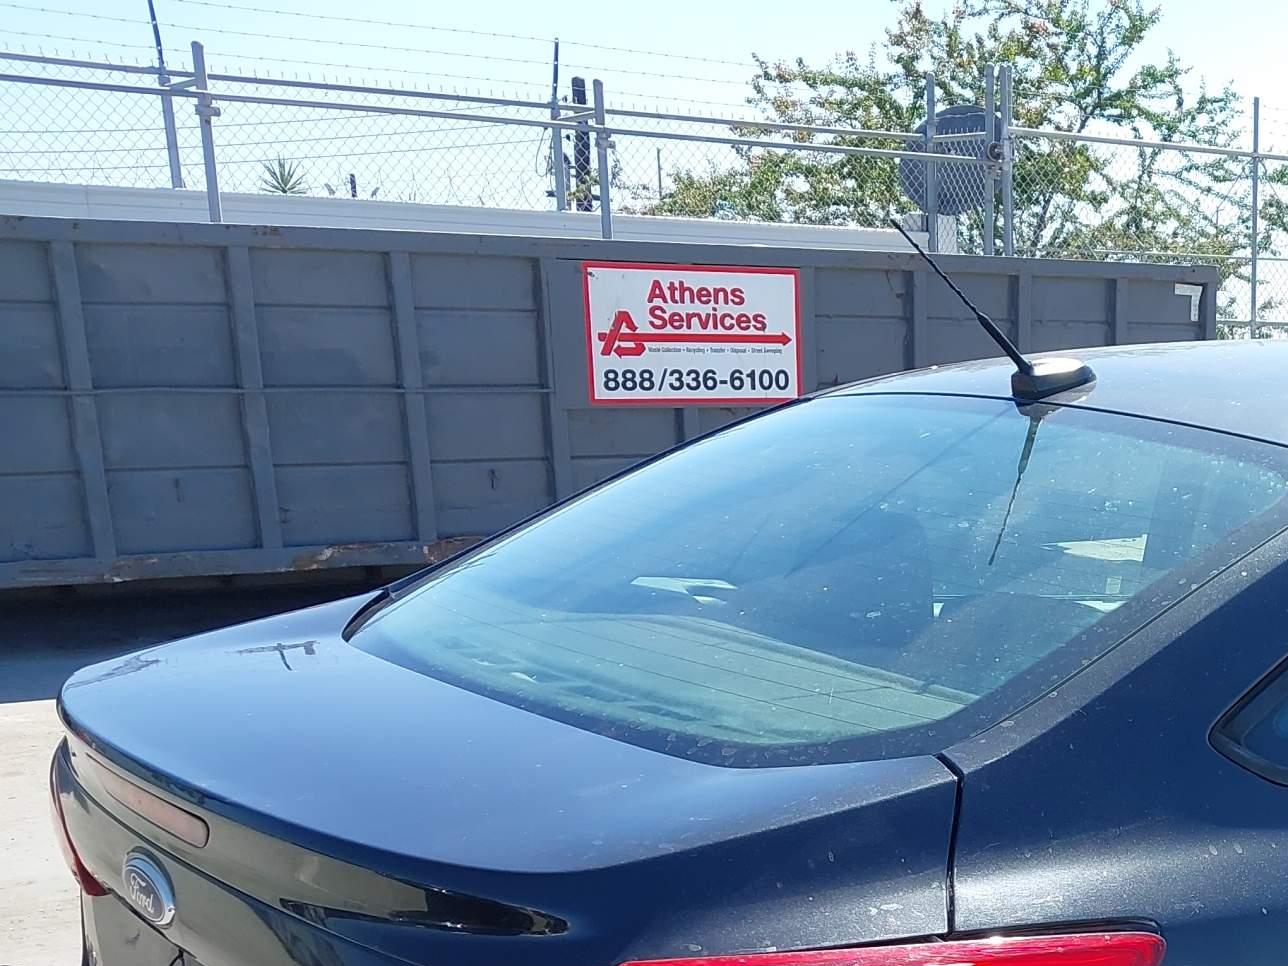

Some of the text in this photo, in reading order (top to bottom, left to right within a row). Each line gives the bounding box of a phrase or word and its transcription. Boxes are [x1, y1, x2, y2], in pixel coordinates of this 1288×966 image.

[647, 279, 745, 306] Athens
[648, 304, 767, 332] Services
[603, 368, 790, 392] 888/336-6100
[130, 873, 155, 914] Ford
